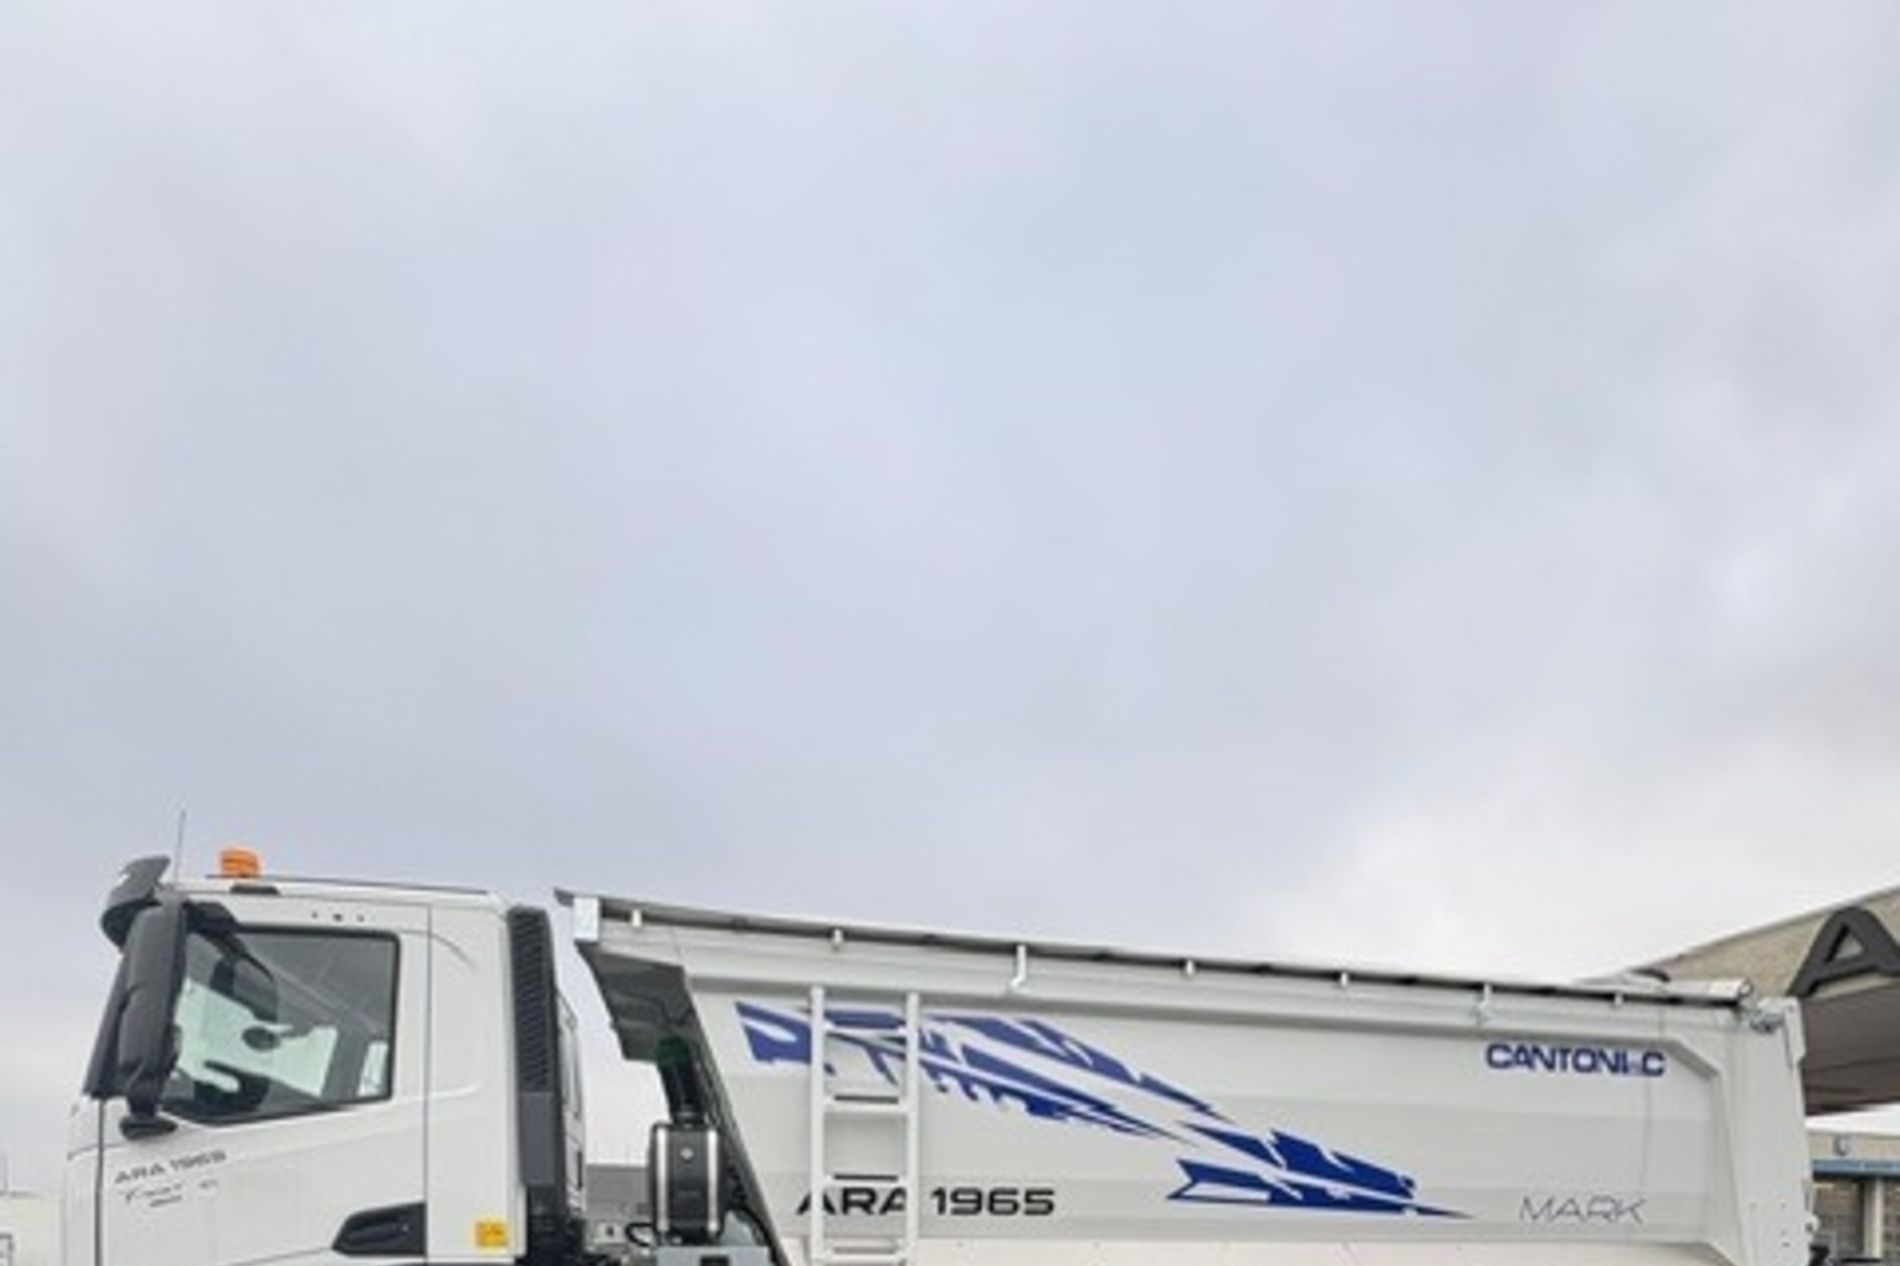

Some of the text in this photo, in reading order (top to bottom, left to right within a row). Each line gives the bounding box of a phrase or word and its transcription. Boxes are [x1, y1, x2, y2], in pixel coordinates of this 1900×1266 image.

[796, 1186, 1055, 1216] ARA 1965
[1520, 1195, 1648, 1224] MARK
